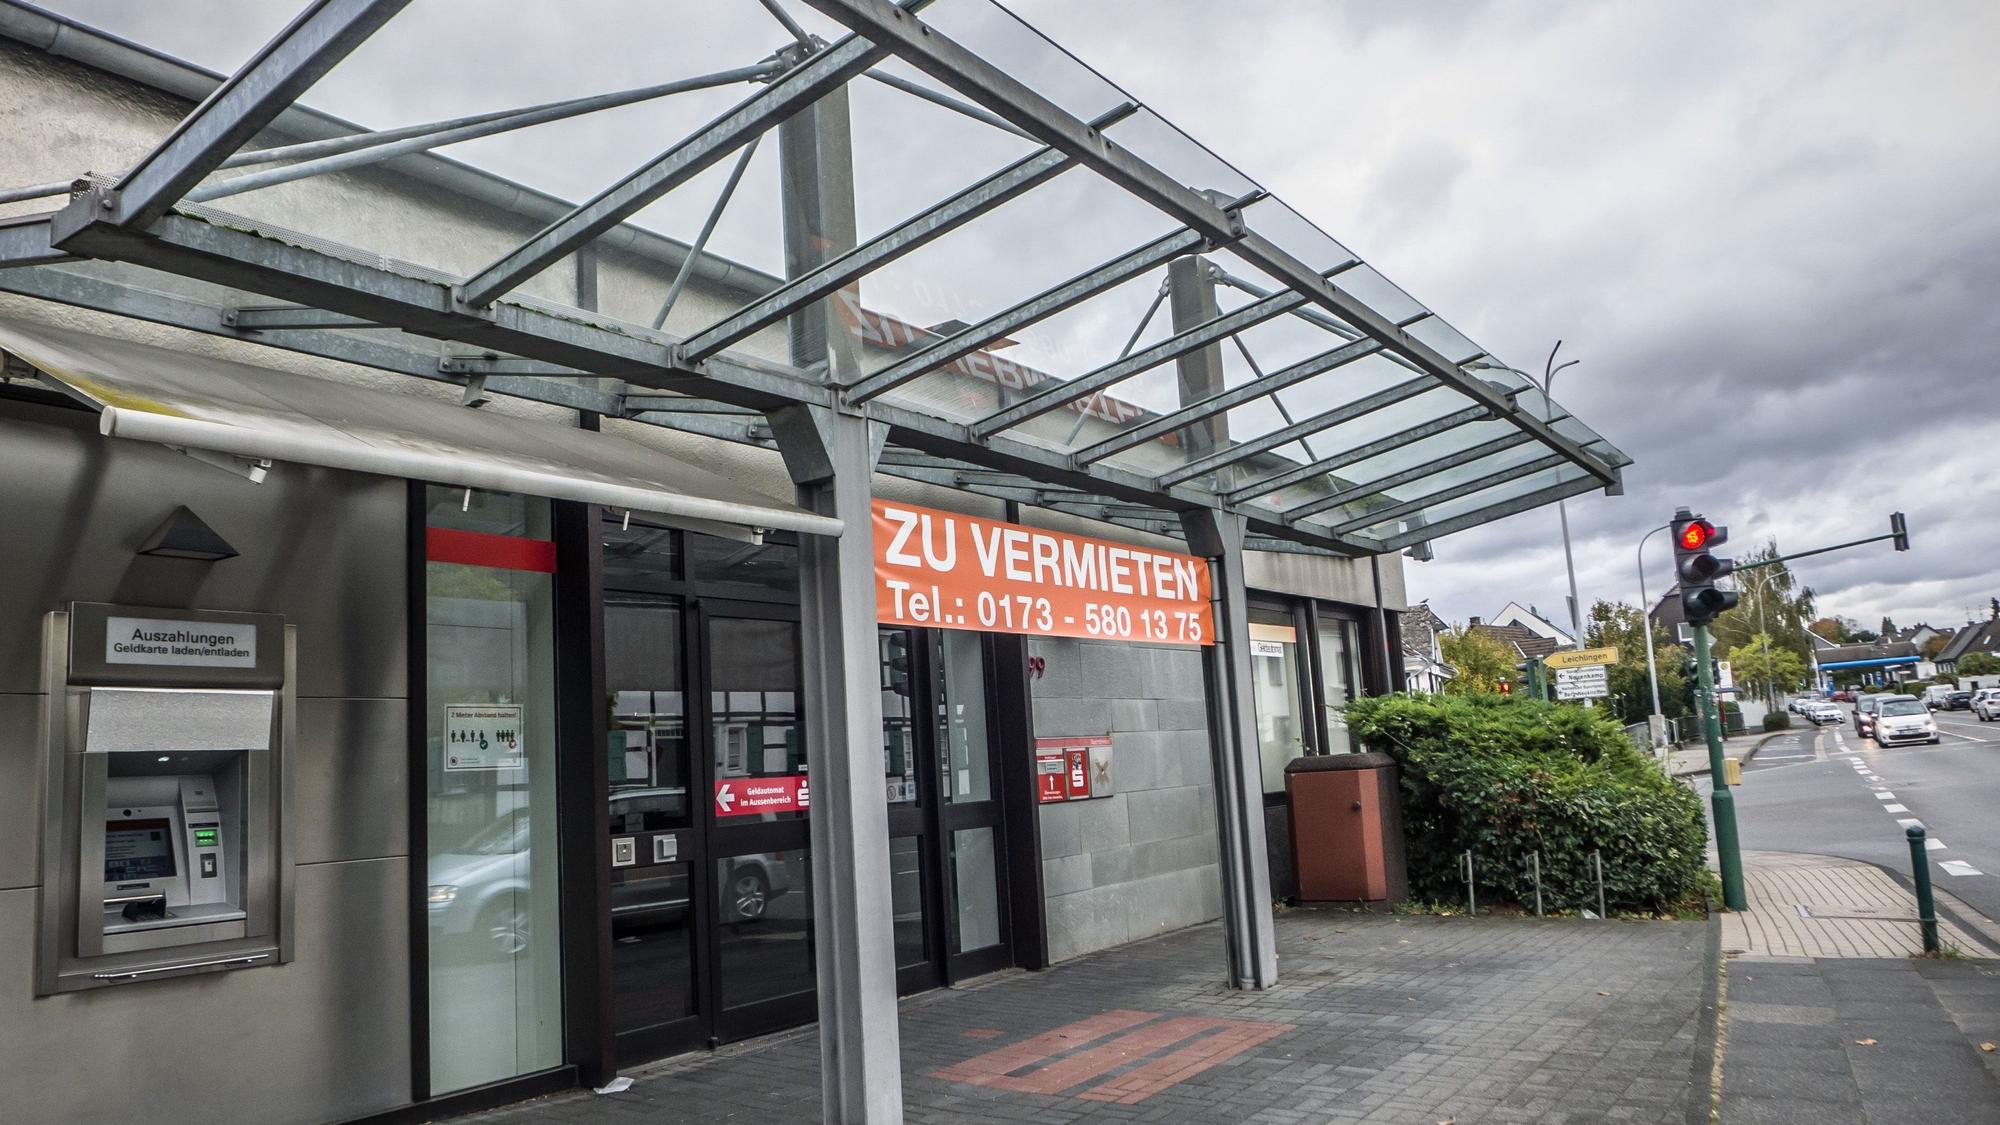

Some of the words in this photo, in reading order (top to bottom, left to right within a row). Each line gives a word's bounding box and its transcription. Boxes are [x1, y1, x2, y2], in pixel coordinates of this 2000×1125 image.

[884, 508, 956, 572] ZU
[970, 522, 1198, 601] VERMIETEN
[886, 580, 964, 624] Tel.:
[978, 591, 1053, 631] 0173
[1085, 603, 1131, 637] 580
[1141, 609, 1168, 640] 13
[1174, 611, 1202, 642] 75
[131, 628, 234, 646] Auszahlungen
[113, 643, 168, 654] Geldkarte
[171, 645, 249, 657] laden/entladen
[1562, 654, 1608, 663] Leichlingen
[747, 787, 784, 796] Geldautomat
[740, 798, 749, 807] im
[749, 796, 792, 806] Aussenbereich
